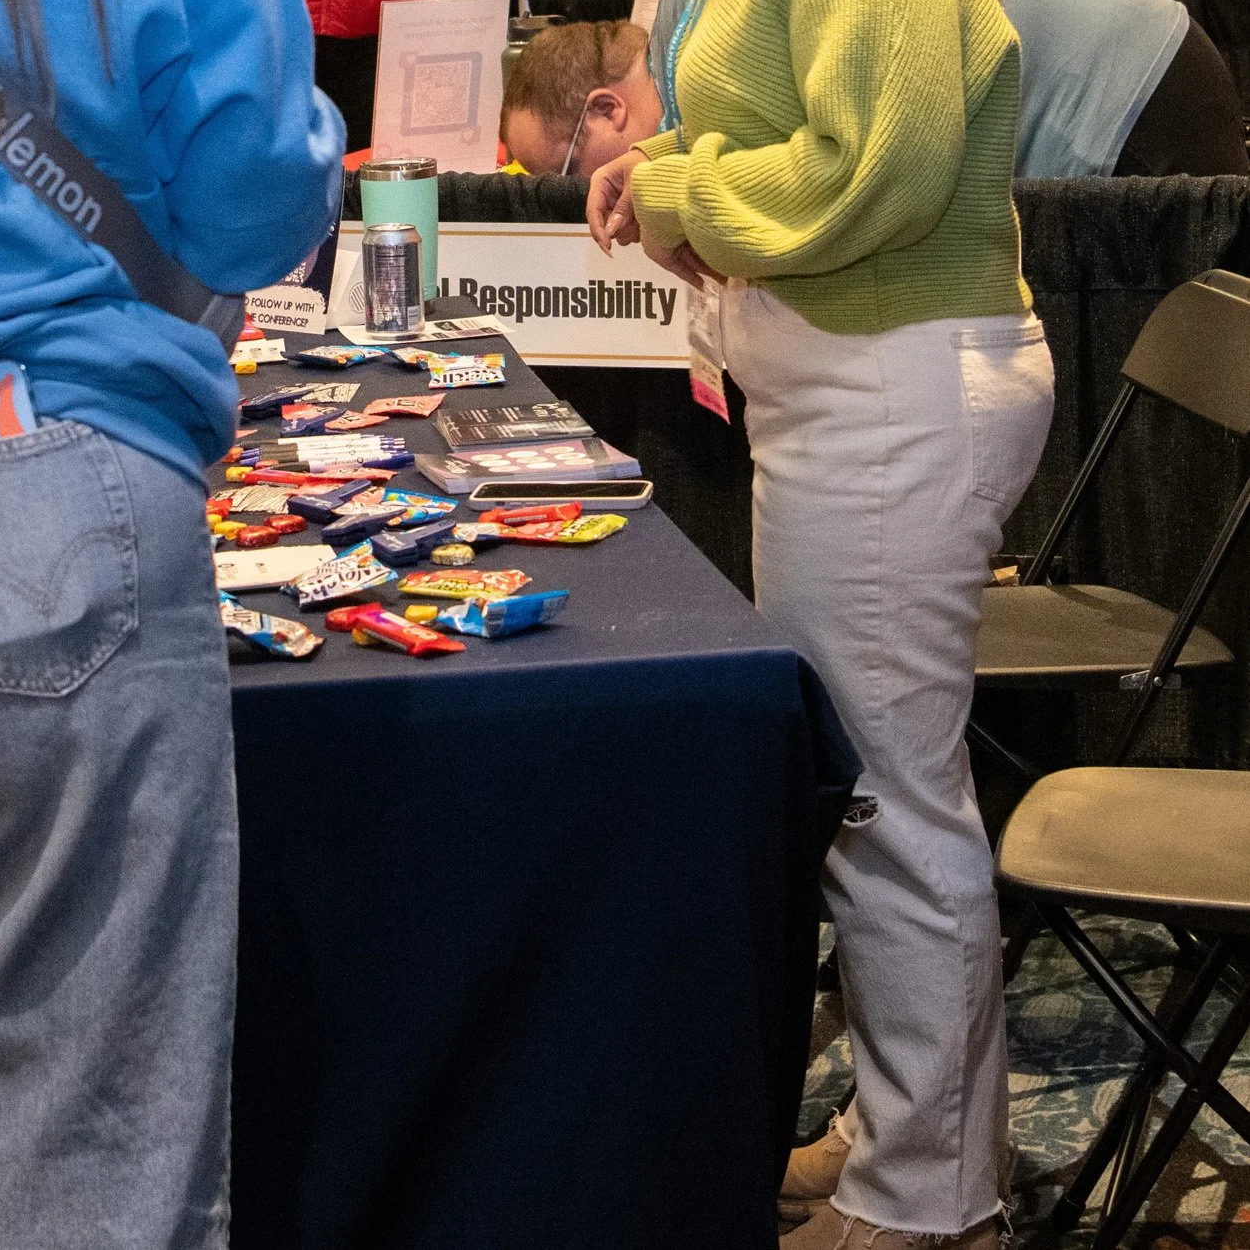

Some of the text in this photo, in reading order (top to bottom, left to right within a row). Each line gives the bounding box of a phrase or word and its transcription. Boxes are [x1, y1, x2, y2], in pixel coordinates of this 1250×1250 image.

[666, 22, 685, 78] CENTRAL
[251, 298, 282, 309] FOLLOW
[283, 301, 293, 310] UP
[295, 302, 315, 313] WITH
[459, 277, 678, 326] Responsibility
[258, 313, 308, 328] CONFERENCE?
